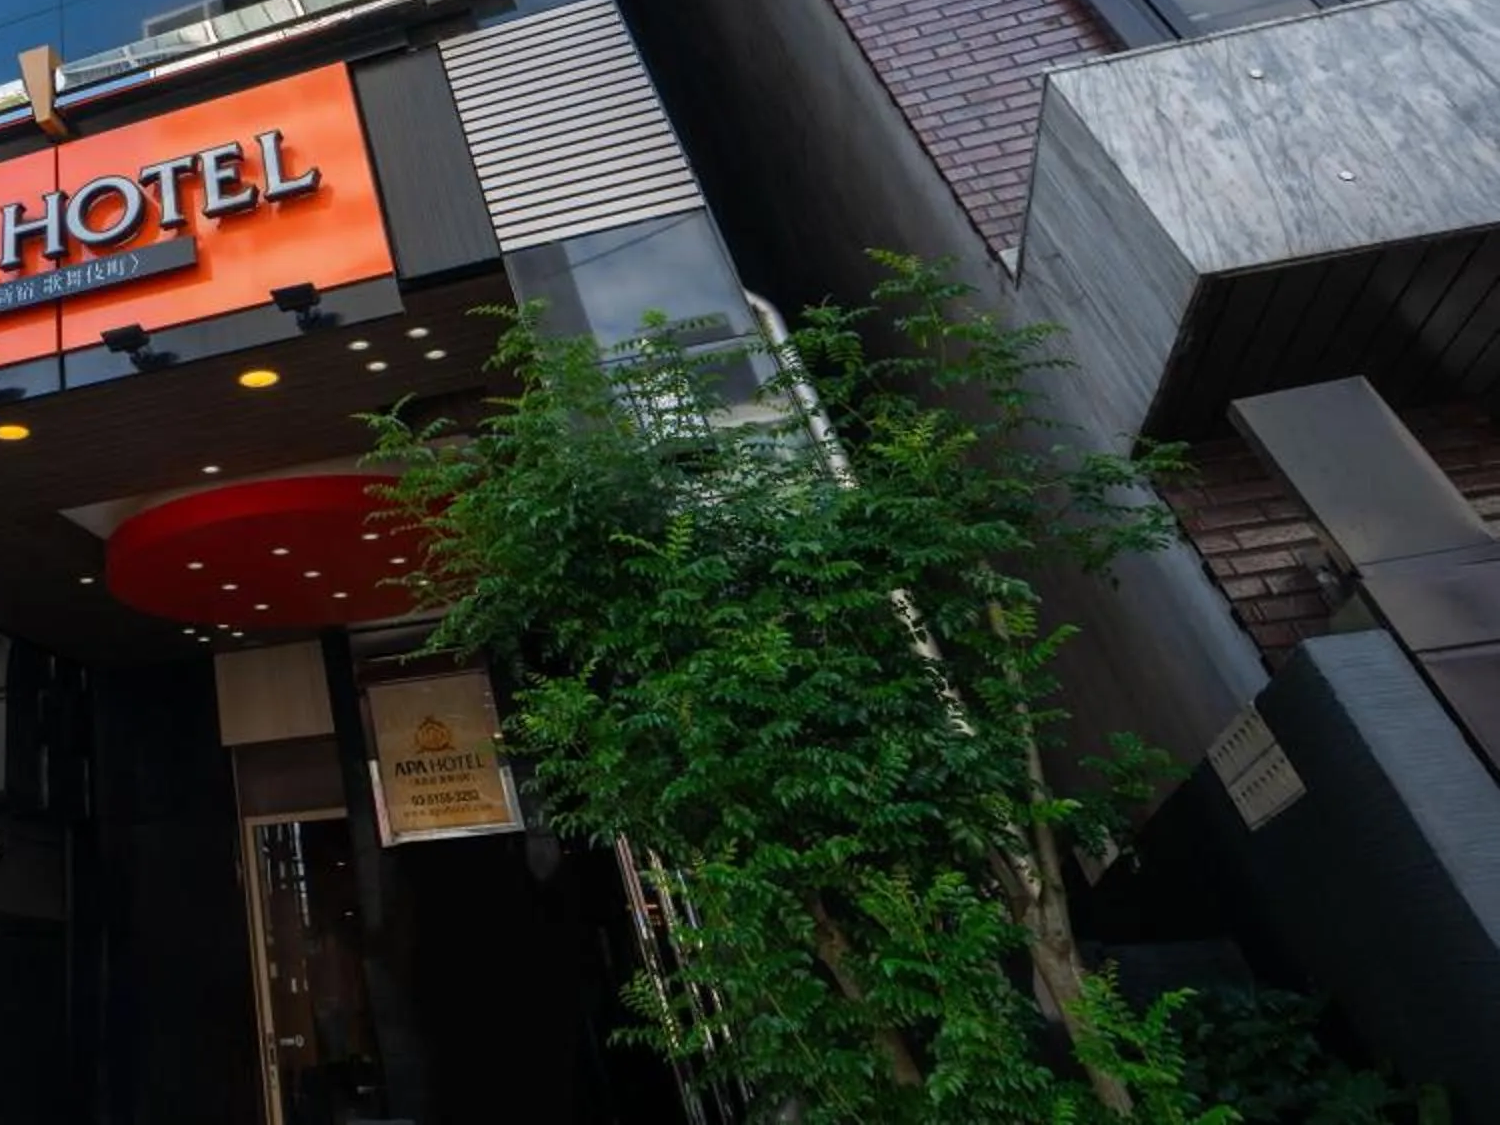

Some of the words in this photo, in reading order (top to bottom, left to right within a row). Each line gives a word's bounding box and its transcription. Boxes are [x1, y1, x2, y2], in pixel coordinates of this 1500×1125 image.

[0, 128, 322, 271] HOTEL
[394, 760, 428, 777] APA
[430, 752, 485, 773] HOTEL
